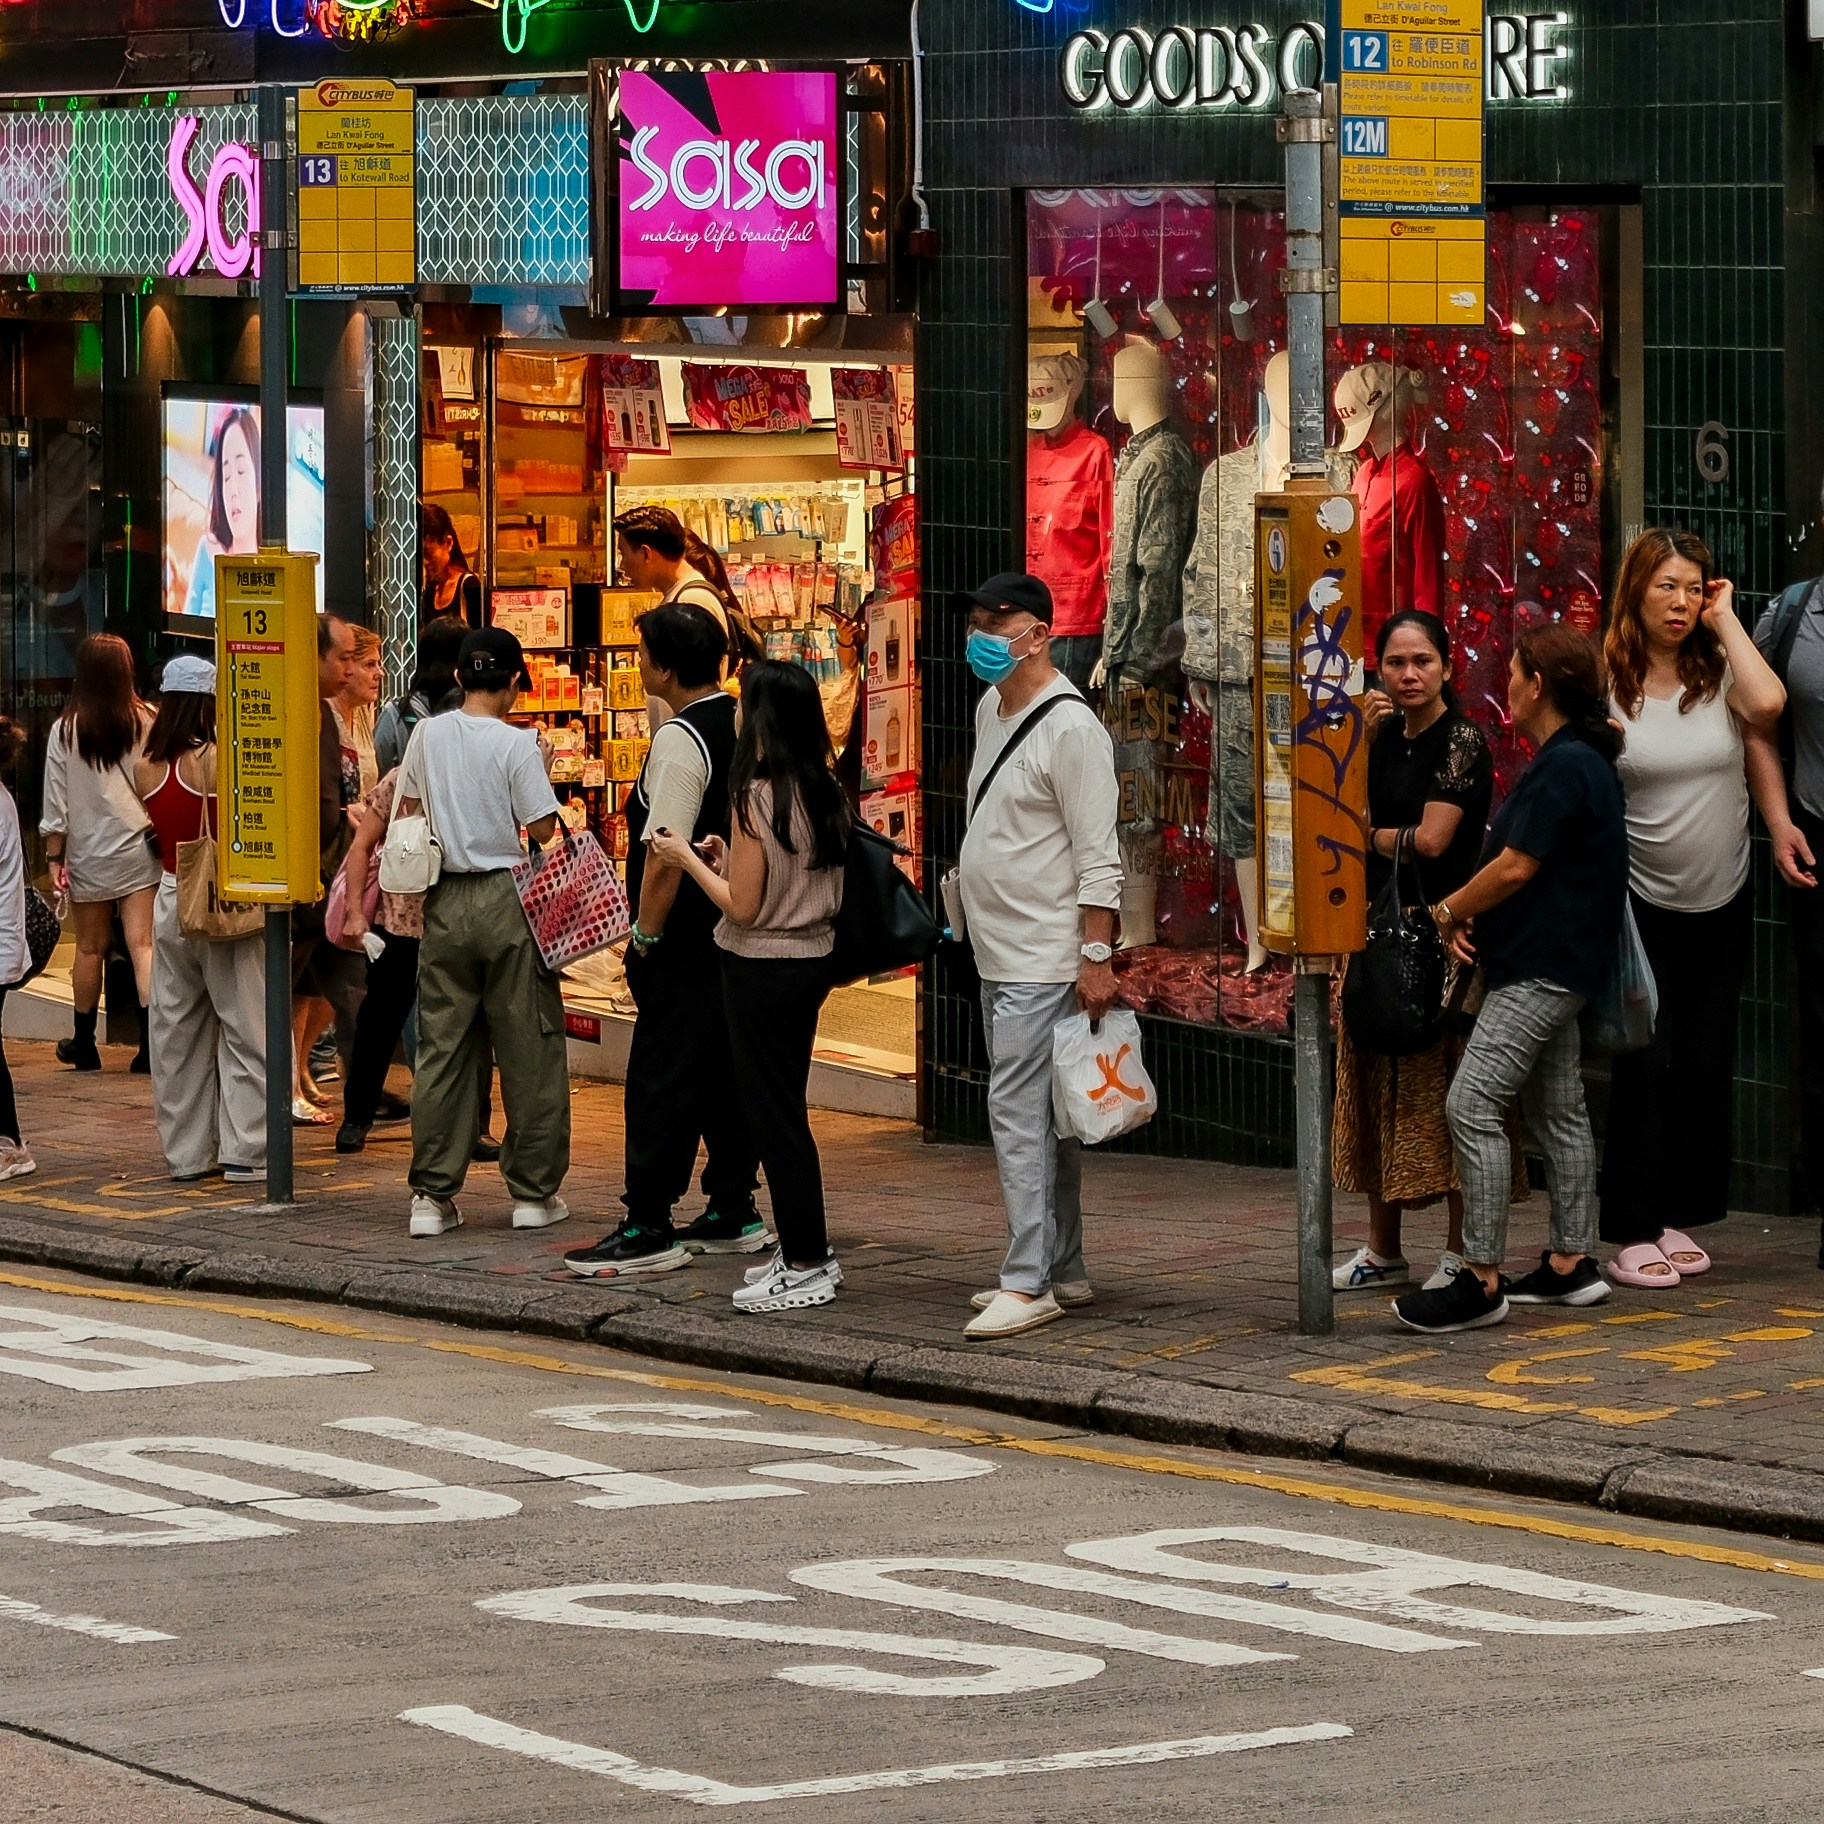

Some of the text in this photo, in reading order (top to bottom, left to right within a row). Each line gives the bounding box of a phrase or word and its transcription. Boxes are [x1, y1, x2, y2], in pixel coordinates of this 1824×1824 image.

[1376, 1, 1449, 14] Lan Kwai Fong
[1402, 15, 1437, 27] D'Aguilar
[1438, 17, 1461, 27] Street
[1350, 37, 1382, 68] 12
[1392, 37, 1471, 56] 往 羅便臣道
[1061, 11, 1573, 111] GOODS O RE
[1392, 56, 1477, 71] to Robinson Rd
[329, 90, 373, 100] CITYBUS
[326, 130, 385, 140] Lan Kwai Fong
[1344, 121, 1385, 154] 12M
[376, 141, 395, 149] Street
[305, 159, 331, 184] 13
[629, 125, 825, 211] Sasa
[340, 173, 348, 182] to
[389, 173, 410, 182] Road
[1343, 176, 1356, 185] The
[1358, 177, 1379, 186] above
[1381, 178, 1401, 186] route
[168, 116, 261, 277] Sa
[1370, 188, 1393, 197] please
[1394, 188, 1411, 197] refer
[1395, 203, 1470, 214] www.citybus.com.hk
[640, 220, 815, 253] making life beautiful
[728, 394, 768, 432] SALE
[1696, 421, 1729, 483] 6
[243, 609, 268, 635] 13
[240, 661, 261, 674] 大館
[240, 688, 271, 701] 孫中山
[241, 703, 272, 715] 紀念館
[1114, 685, 1180, 746] NESE
[242, 737, 283, 750] 香港醫學
[242, 752, 273, 764] 博物館
[243, 786, 273, 798] 般咸道
[1119, 777, 1196, 829] ENIM
[243, 812, 263, 825] 柏道
[475, 1525, 1779, 1696] BUS
